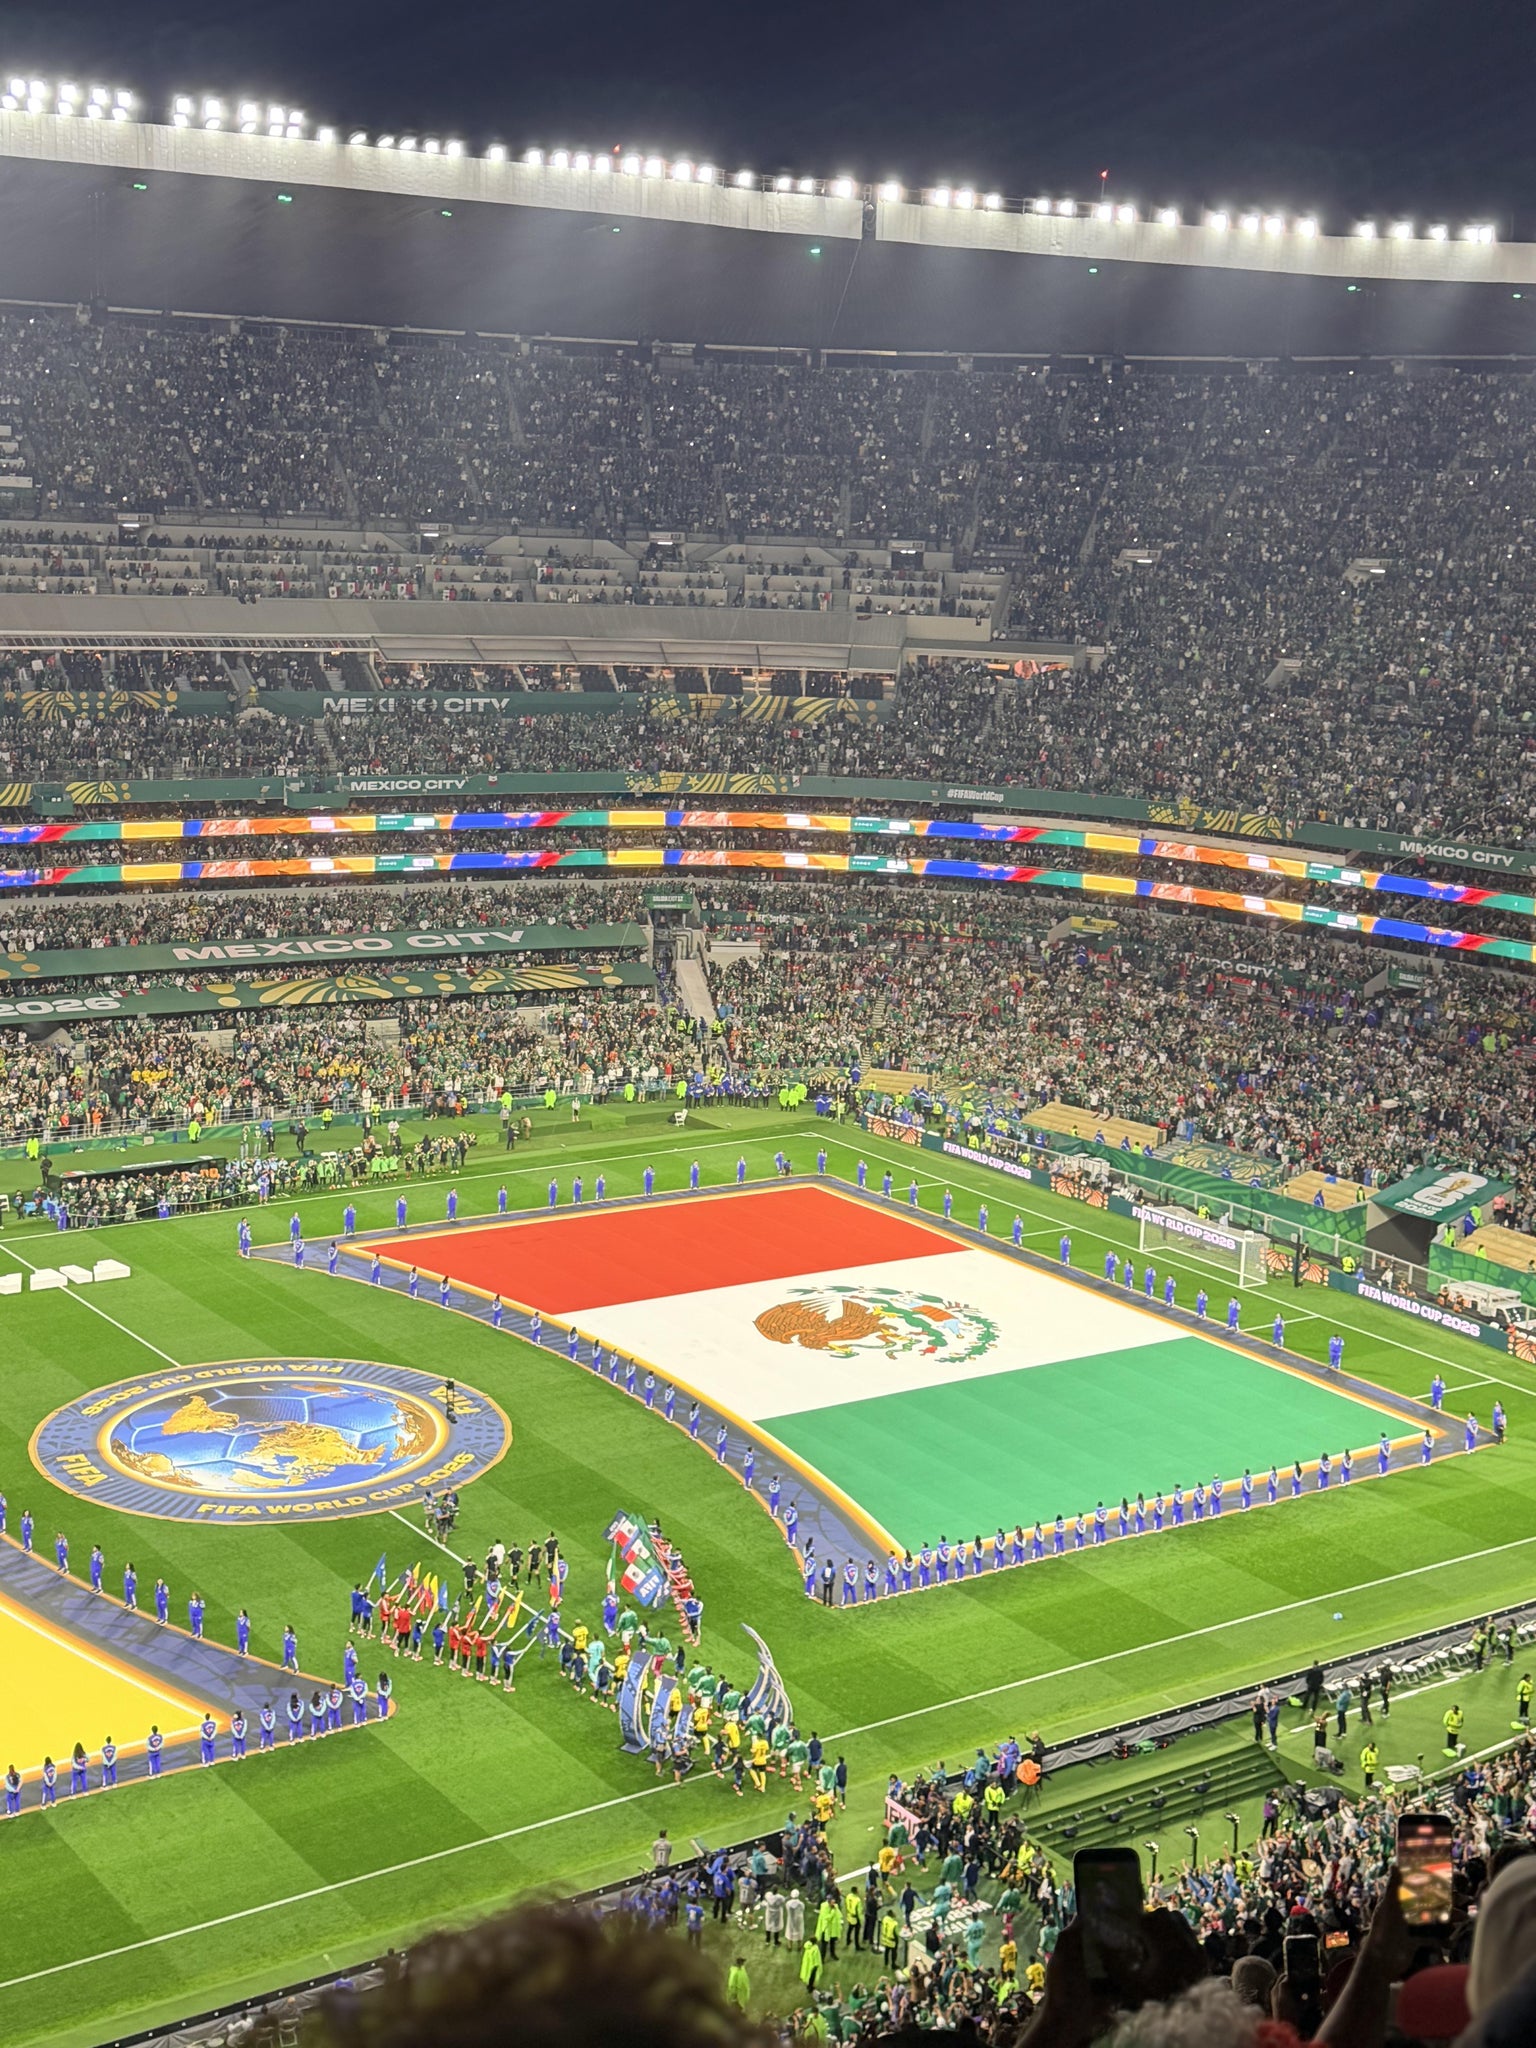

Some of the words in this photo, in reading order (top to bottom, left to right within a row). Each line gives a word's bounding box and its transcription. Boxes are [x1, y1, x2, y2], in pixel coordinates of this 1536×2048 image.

[443, 697, 510, 713] CITY
[350, 779, 422, 792] MEXICO
[423, 779, 466, 790] CITY
[947, 788, 1004, 803] #FIFAWorldCup
[1471, 851, 1515, 867] CITY
[172, 937, 394, 961] MEXICO
[406, 930, 525, 949] CITY
[1235, 963, 1273, 978] CITY
[943, 1141, 961, 1155] FIFA
[960, 1146, 988, 1164] WORLD
[988, 1156, 1004, 1169] CUP
[1394, 1201, 1437, 1217] 2026
[1183, 1224, 1203, 1238] CUP
[1358, 1283, 1382, 1301] FIFA
[1381, 1290, 1421, 1314] WORLD
[1420, 1305, 1442, 1322] CUP
[1441, 1313, 1480, 1337] 2026
[195, 1365, 285, 1379] WORLD
[289, 1365, 345, 1374] FIFA
[149, 1374, 193, 1390] CUP
[81, 1385, 149, 1417] 2026
[56, 1453, 108, 1487] FIFA
[197, 1503, 262, 1515] FIFA
[266, 1496, 367, 1514] WORLD
[368, 1483, 415, 1501] CUP
[414, 1450, 476, 1487] 2026
